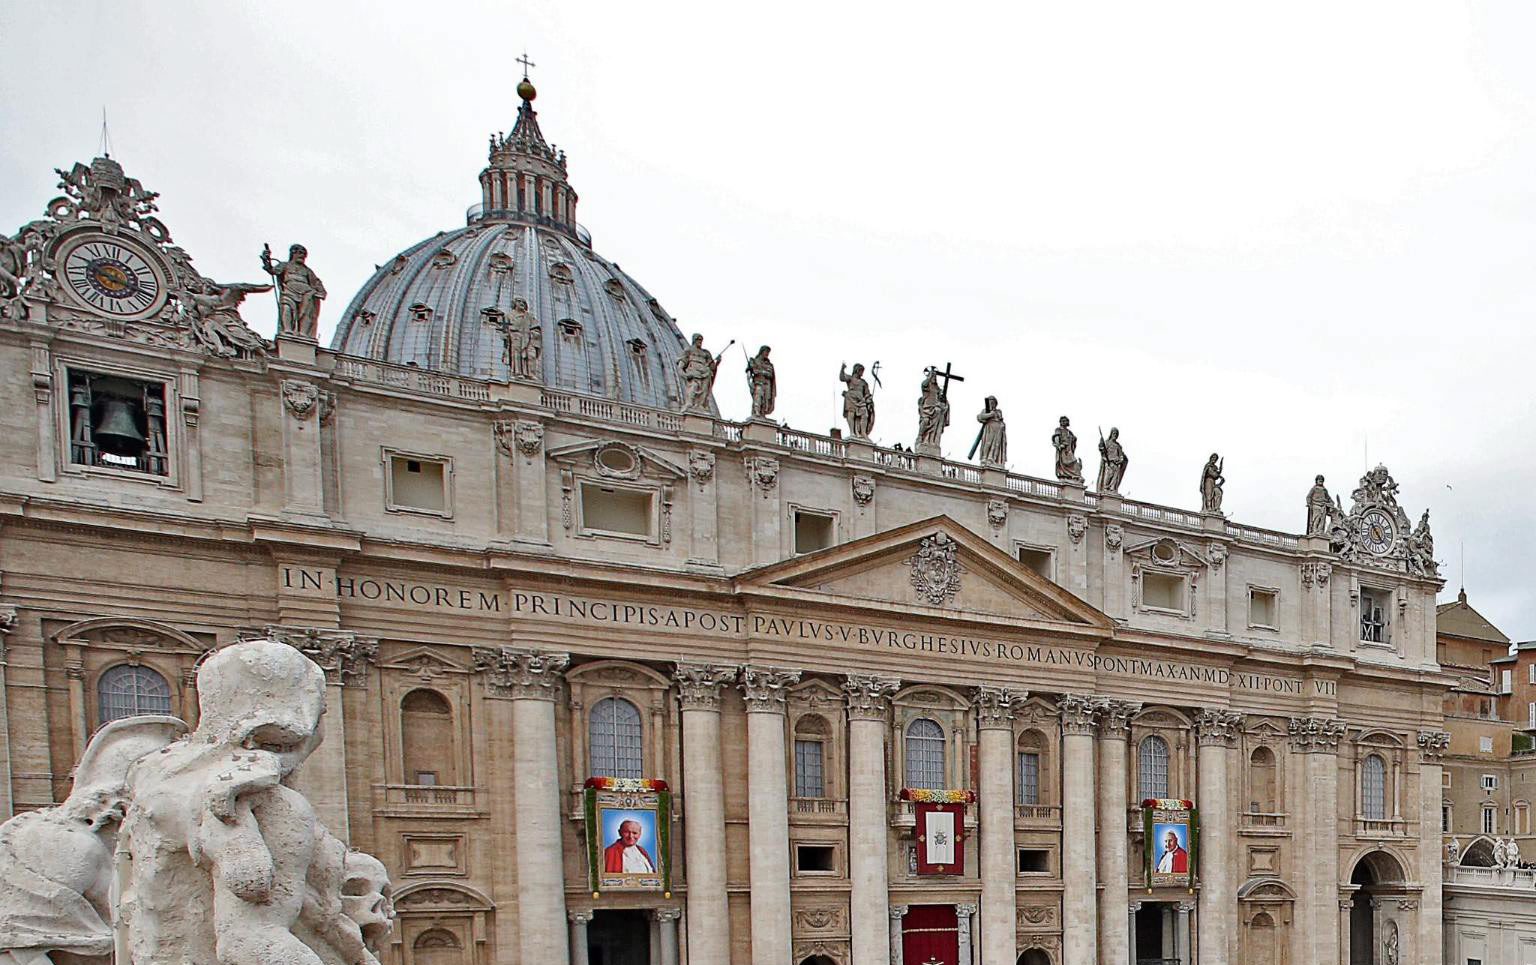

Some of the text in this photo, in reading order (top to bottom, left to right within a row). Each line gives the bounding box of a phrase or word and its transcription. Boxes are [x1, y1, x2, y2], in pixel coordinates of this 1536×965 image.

[283, 568, 1336, 696] IN HONOREM PRINCIPIS APOST PAVLVS V BVRGHESIVS ROMANVS PONT MAX AN MDCXII PONT VII
